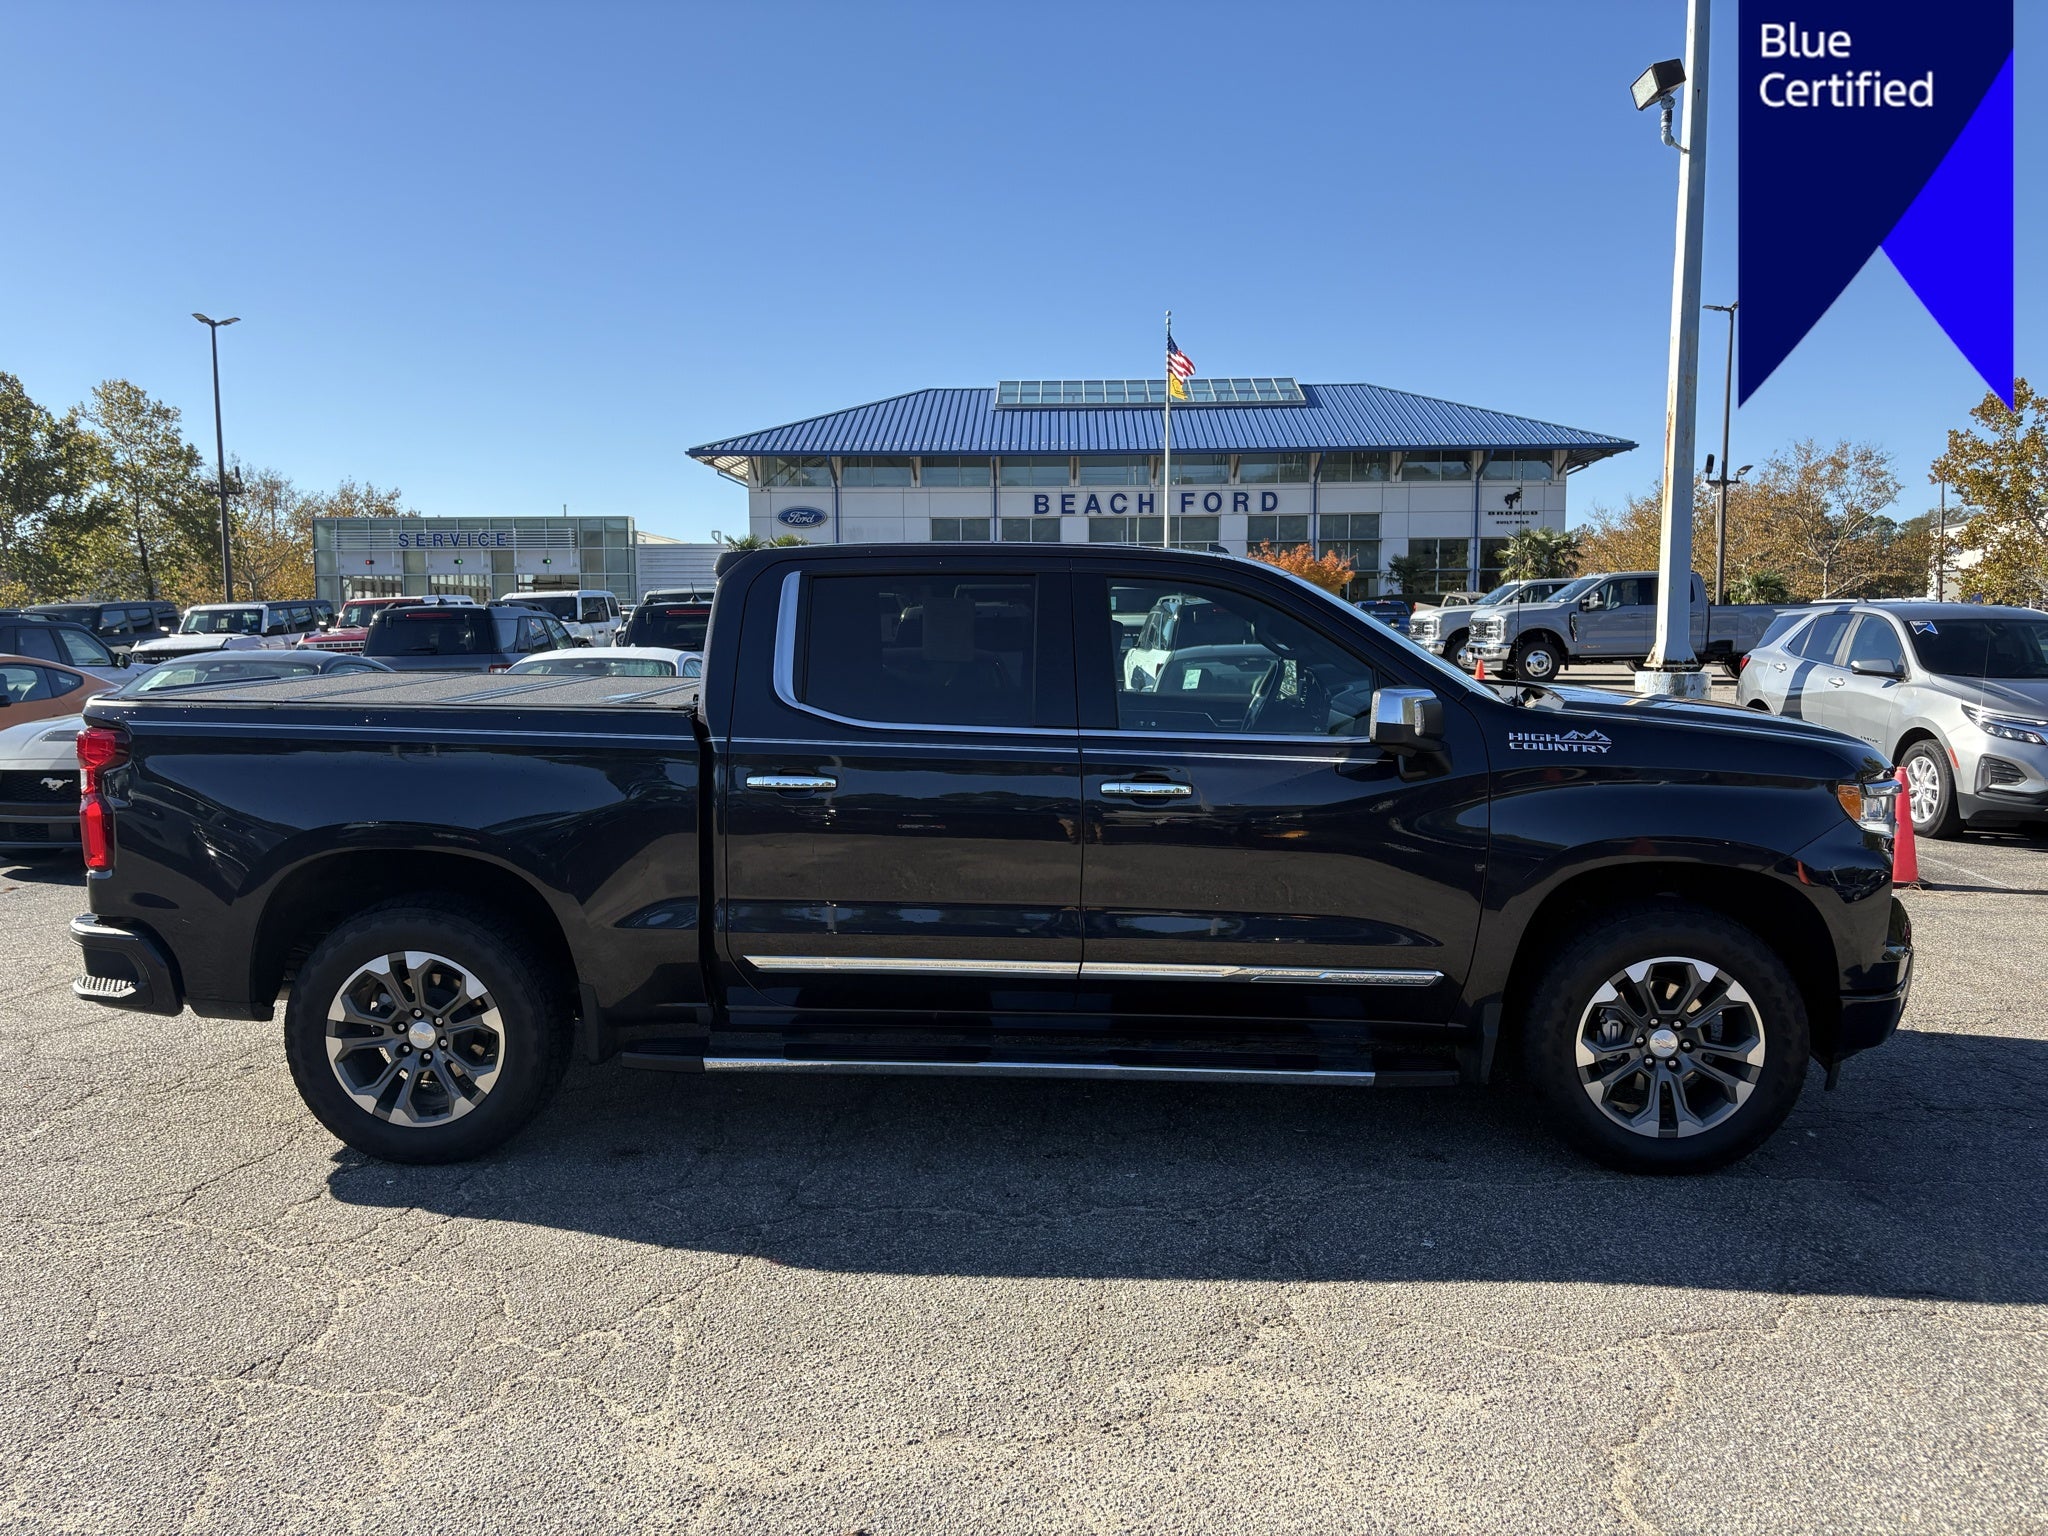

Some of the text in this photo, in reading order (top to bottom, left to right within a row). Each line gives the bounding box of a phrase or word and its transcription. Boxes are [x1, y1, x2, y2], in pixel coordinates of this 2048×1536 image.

[1033, 491, 1279, 515] BEACH FORD
[787, 511, 815, 524] Ford
[398, 532, 508, 548] SERVICE
[1508, 731, 1561, 742] HIGH
[1508, 741, 1612, 754] COUNTRY
